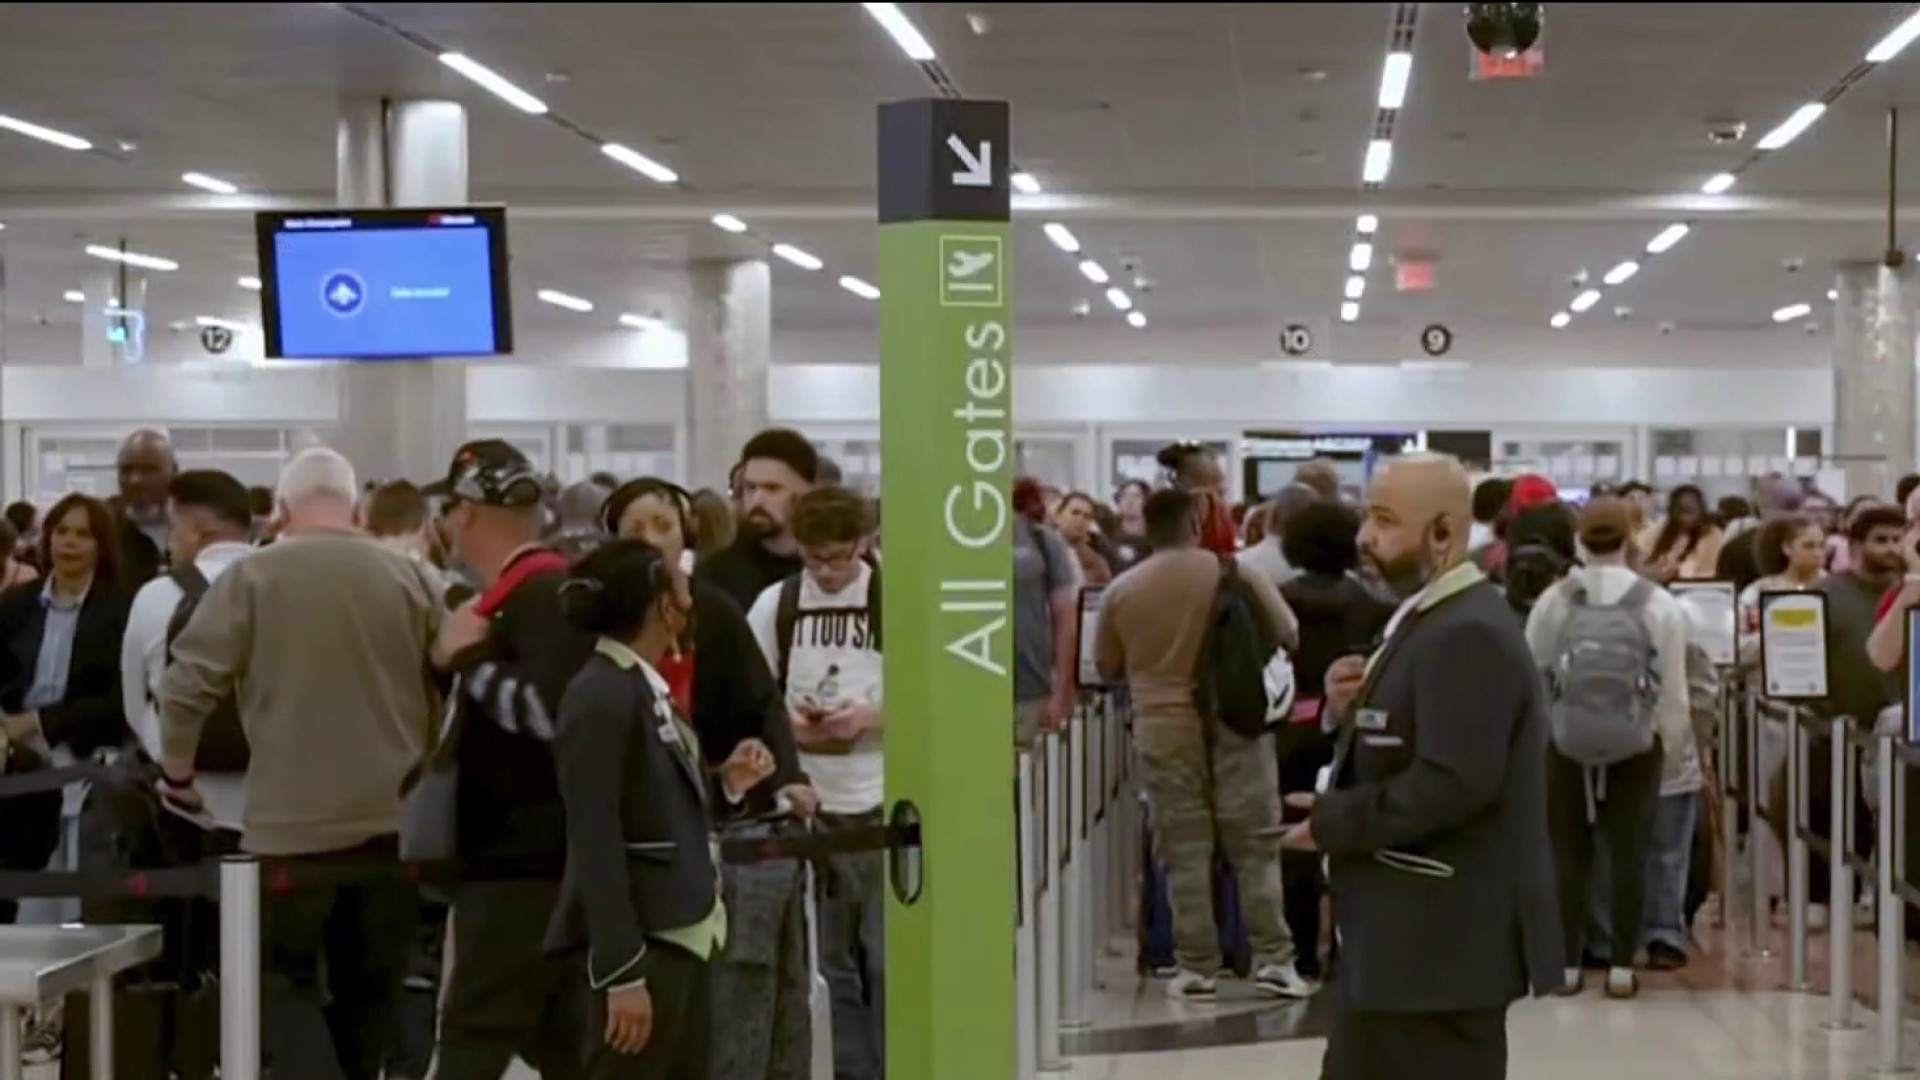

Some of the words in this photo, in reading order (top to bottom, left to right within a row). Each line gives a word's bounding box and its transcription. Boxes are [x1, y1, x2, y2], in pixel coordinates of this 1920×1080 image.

[207, 329, 227, 348] 12
[1285, 329, 1309, 349] 10
[1427, 329, 1445, 350] 9
[944, 320, 1006, 548] Gates
[941, 580, 1006, 675] All
